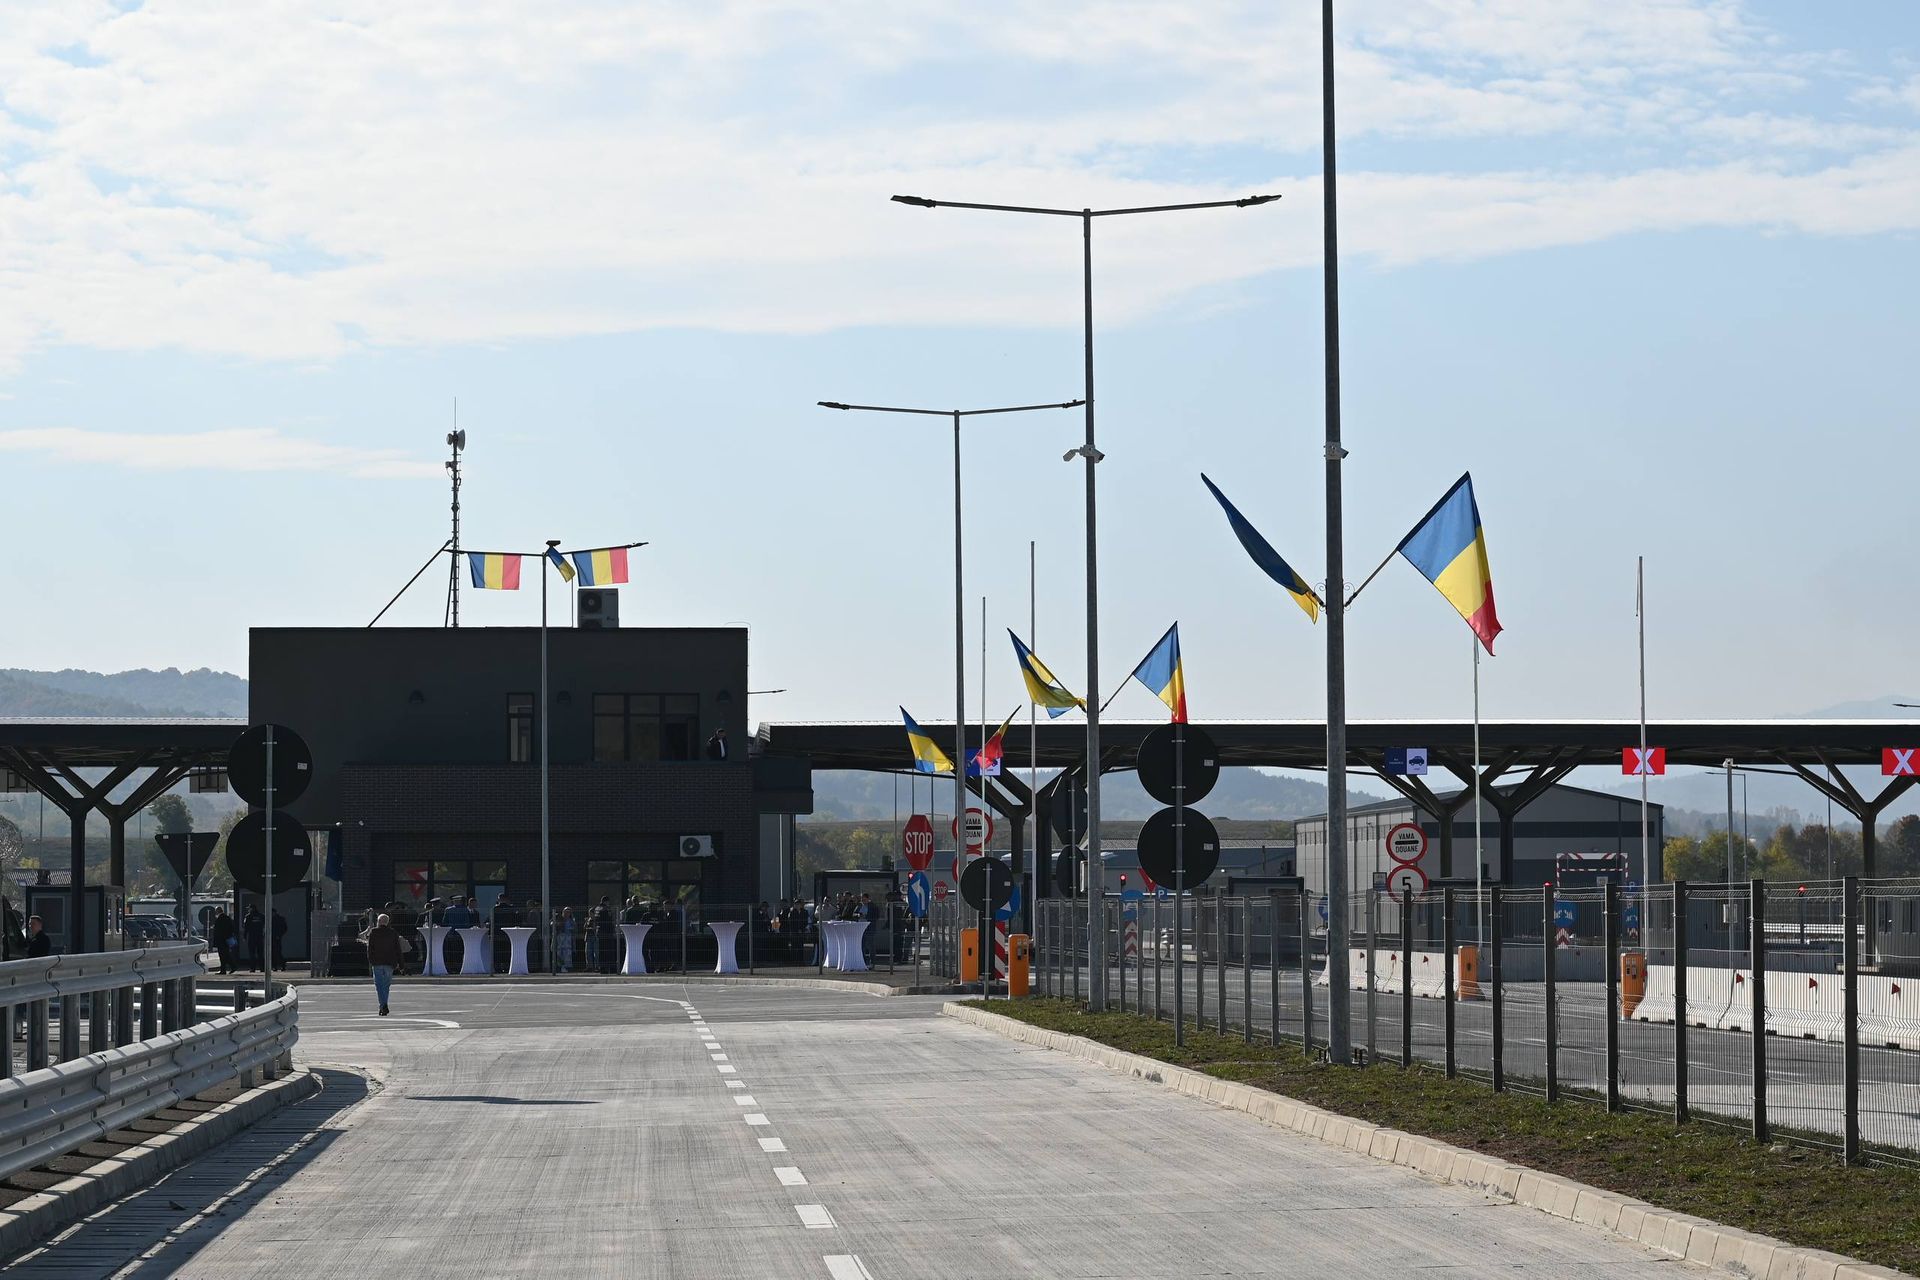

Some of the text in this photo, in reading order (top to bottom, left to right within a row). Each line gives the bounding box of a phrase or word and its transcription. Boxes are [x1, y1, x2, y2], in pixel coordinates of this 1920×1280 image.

[1398, 832, 1415, 840] VAMA
[905, 831, 932, 855] STOP
[1395, 845, 1419, 853] DOUANE
[1402, 876, 1412, 892] 5
[934, 886, 948, 895] STOP
[1158, 889, 1165, 898] P
